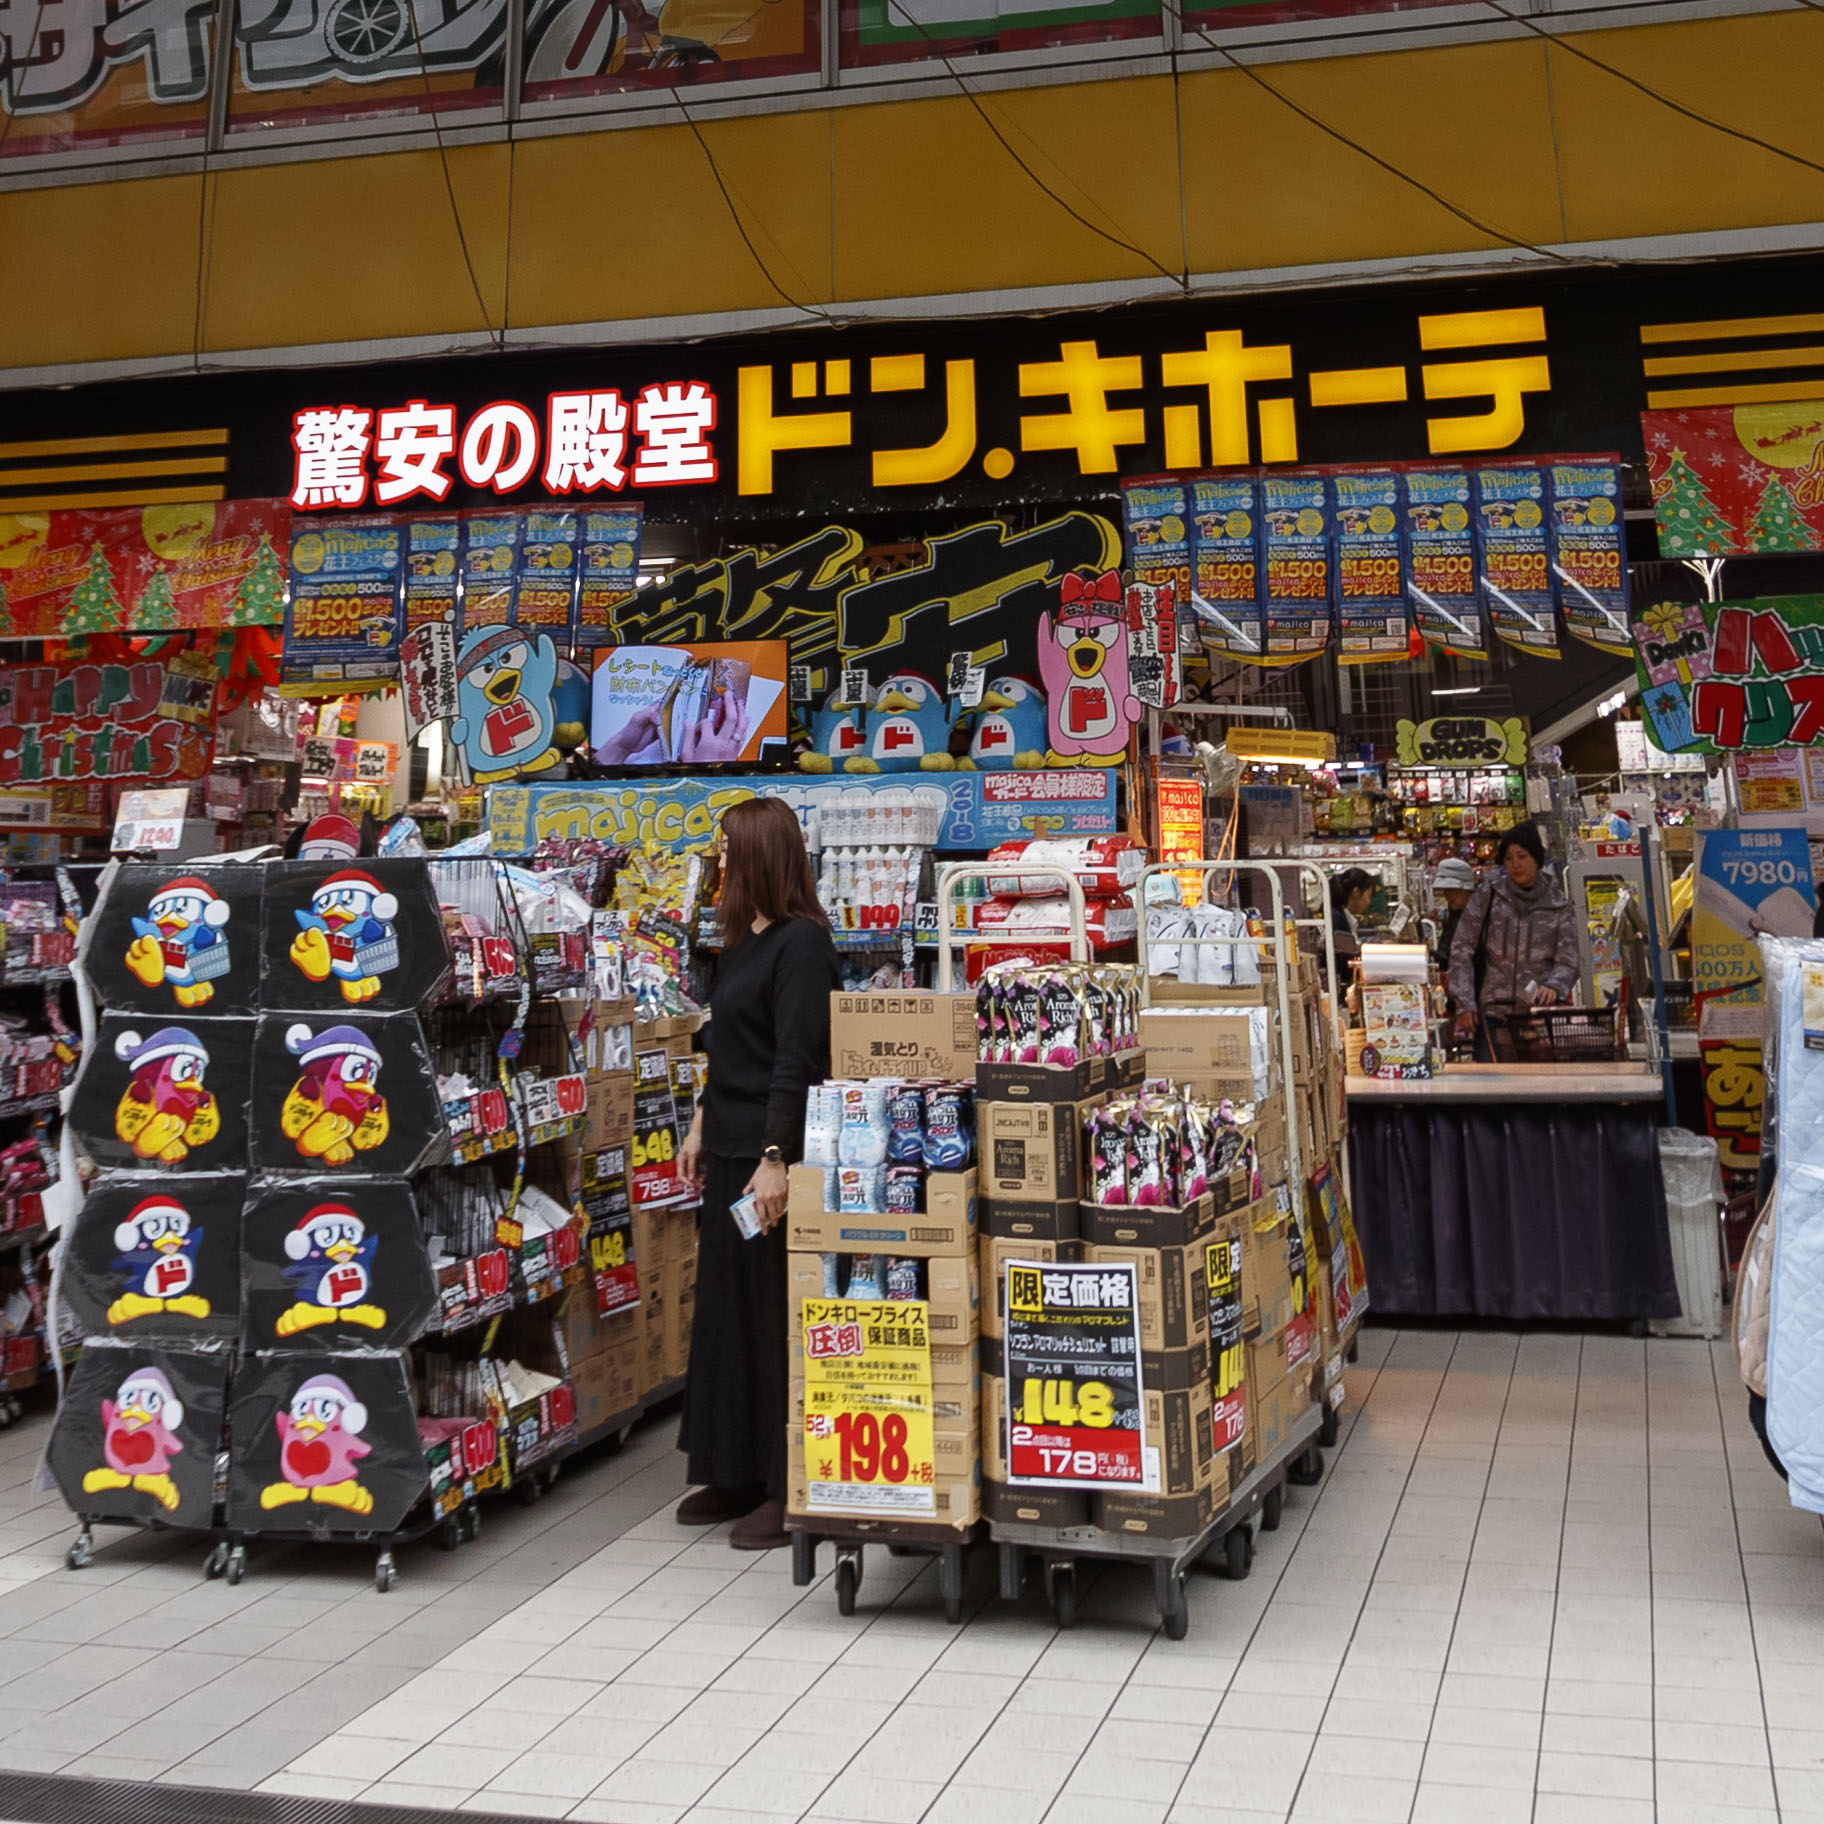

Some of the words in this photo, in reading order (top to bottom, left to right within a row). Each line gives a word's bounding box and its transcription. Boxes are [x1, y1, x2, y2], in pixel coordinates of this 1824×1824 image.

[289, 380, 720, 510] 驚安の殿堂
[1069, 684, 1105, 733] ド
[485, 698, 534, 755] ド
[884, 727, 913, 749] ド
[981, 725, 1006, 749] ド
[1429, 717, 1486, 741] GUM
[1419, 738, 1504, 761] DROPS
[985, 774, 1031, 791] majica
[1604, 843, 1640, 857] たばこ
[1046, 997, 1078, 1012] Aroma
[157, 1259, 187, 1294] ド
[328, 1268, 363, 1304] ド
[1011, 1271, 1131, 1309] 限定価格
[805, 1303, 925, 1325] ドンキロープライス
[807, 1322, 864, 1359] 圧倒
[868, 1326, 926, 1347] 保証商品
[1026, 1363, 1063, 1375] お一人様
[1038, 1448, 1098, 1475] 178
